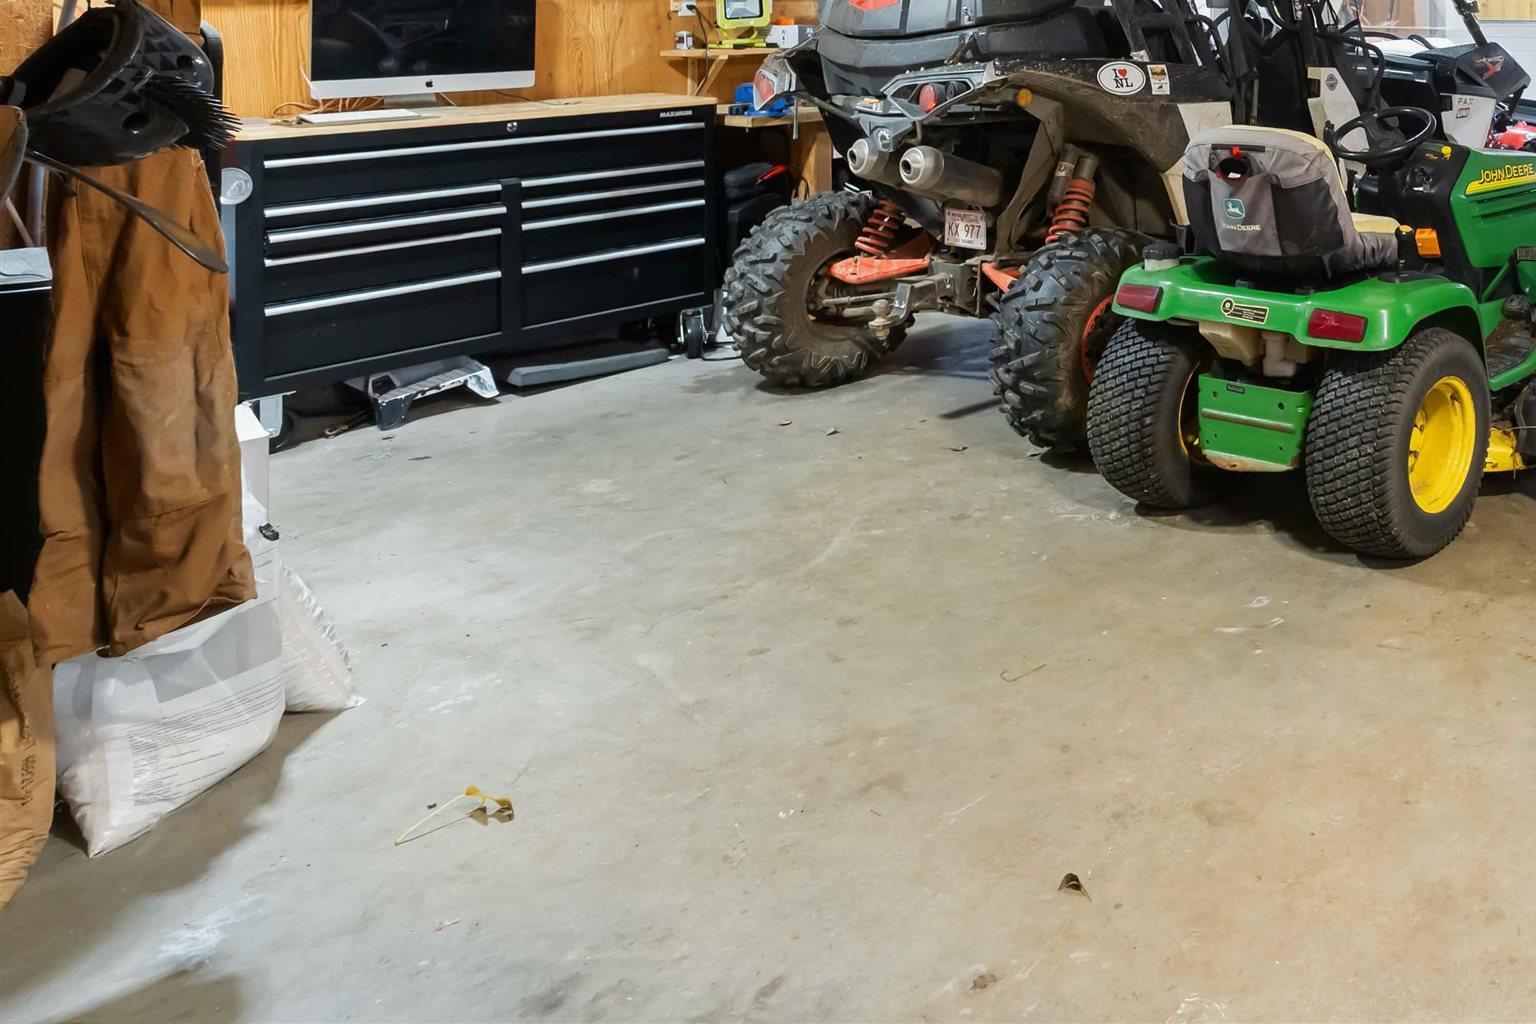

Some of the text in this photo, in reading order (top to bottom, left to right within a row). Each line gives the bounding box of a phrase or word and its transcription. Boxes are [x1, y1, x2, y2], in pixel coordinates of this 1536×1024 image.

[1114, 78, 1133, 88] NL
[1479, 163, 1535, 184] JOHN DEERE
[964, 224, 981, 239] 977
